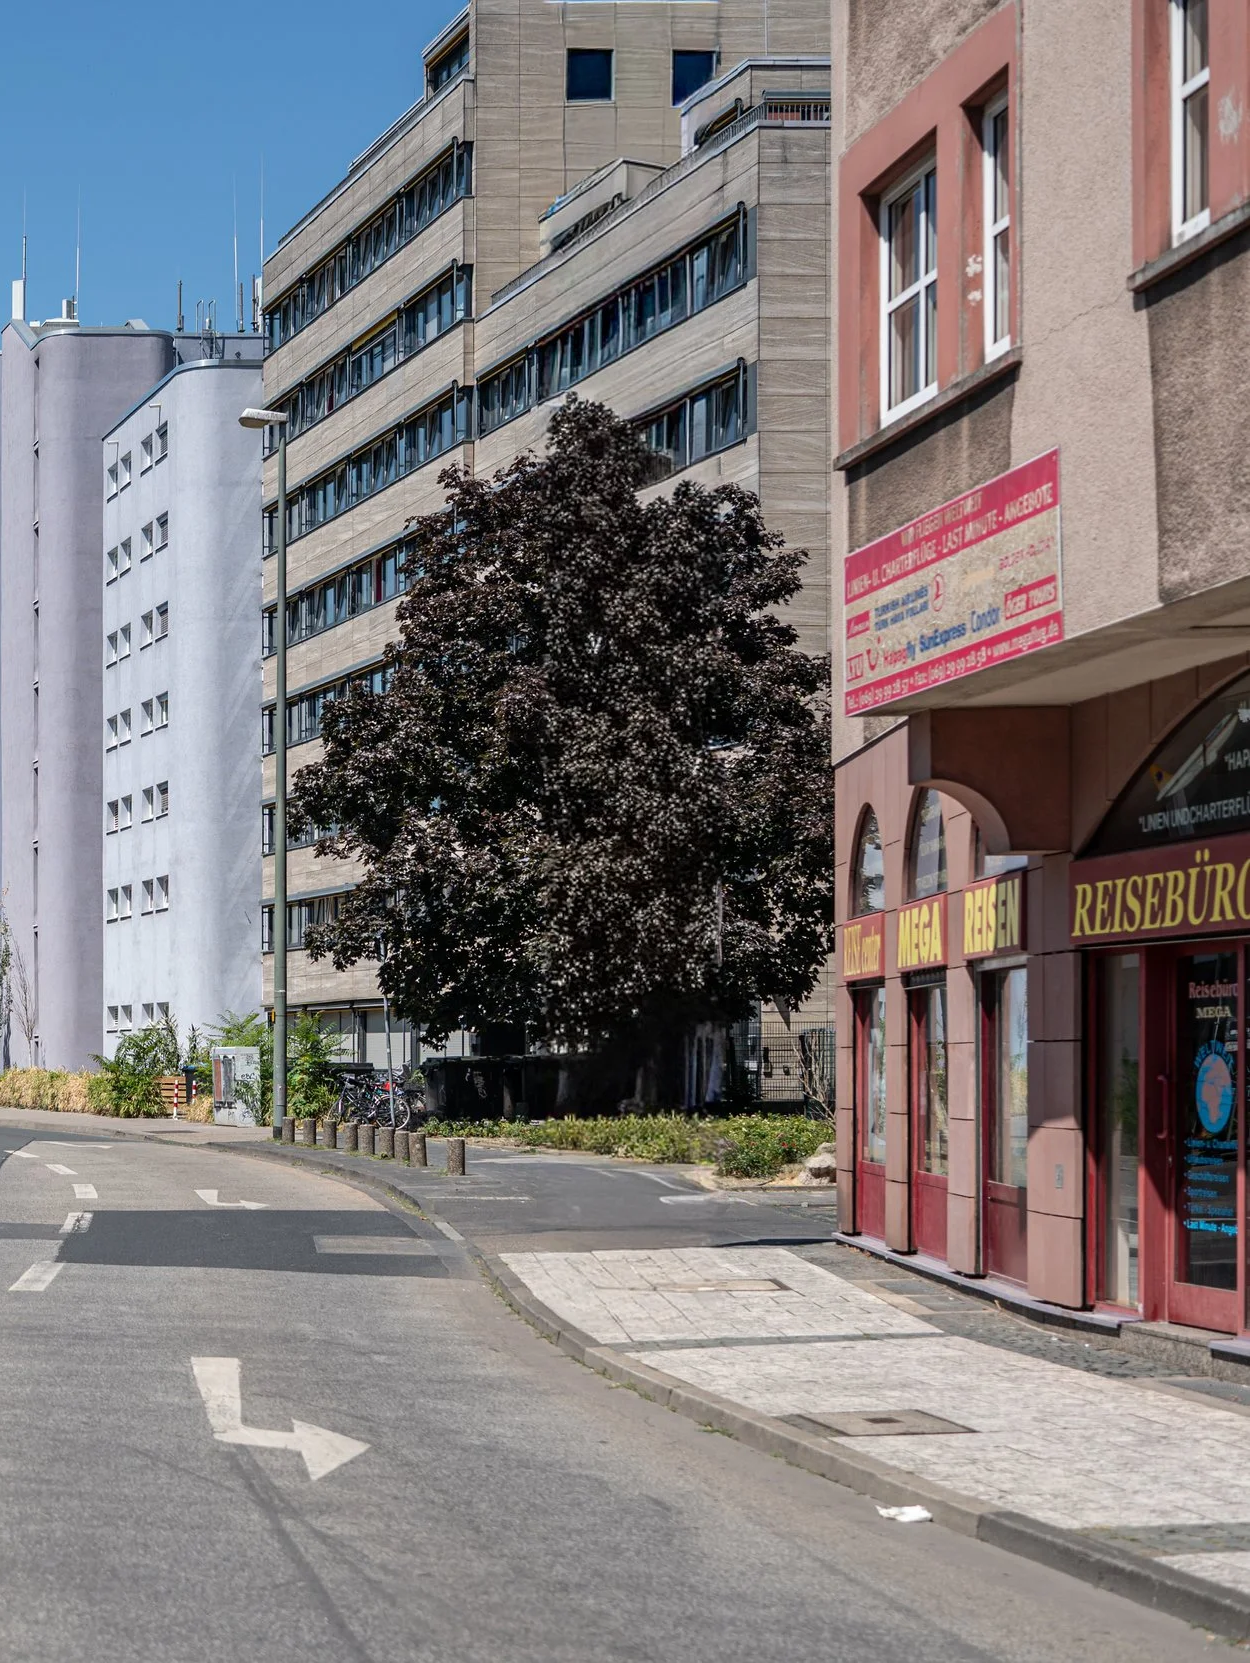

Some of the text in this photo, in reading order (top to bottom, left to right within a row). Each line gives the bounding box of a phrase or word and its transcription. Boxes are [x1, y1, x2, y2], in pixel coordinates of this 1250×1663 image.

[942, 527, 963, 553] LAST
[1004, 482, 1053, 524] ANGEBOTE
[920, 622, 966, 652] SunExpress
[971, 607, 1000, 632] Condor
[897, 901, 942, 969] MEGA
[963, 878, 1020, 954] REISEN
[1195, 1006, 1231, 1018] MEGA
